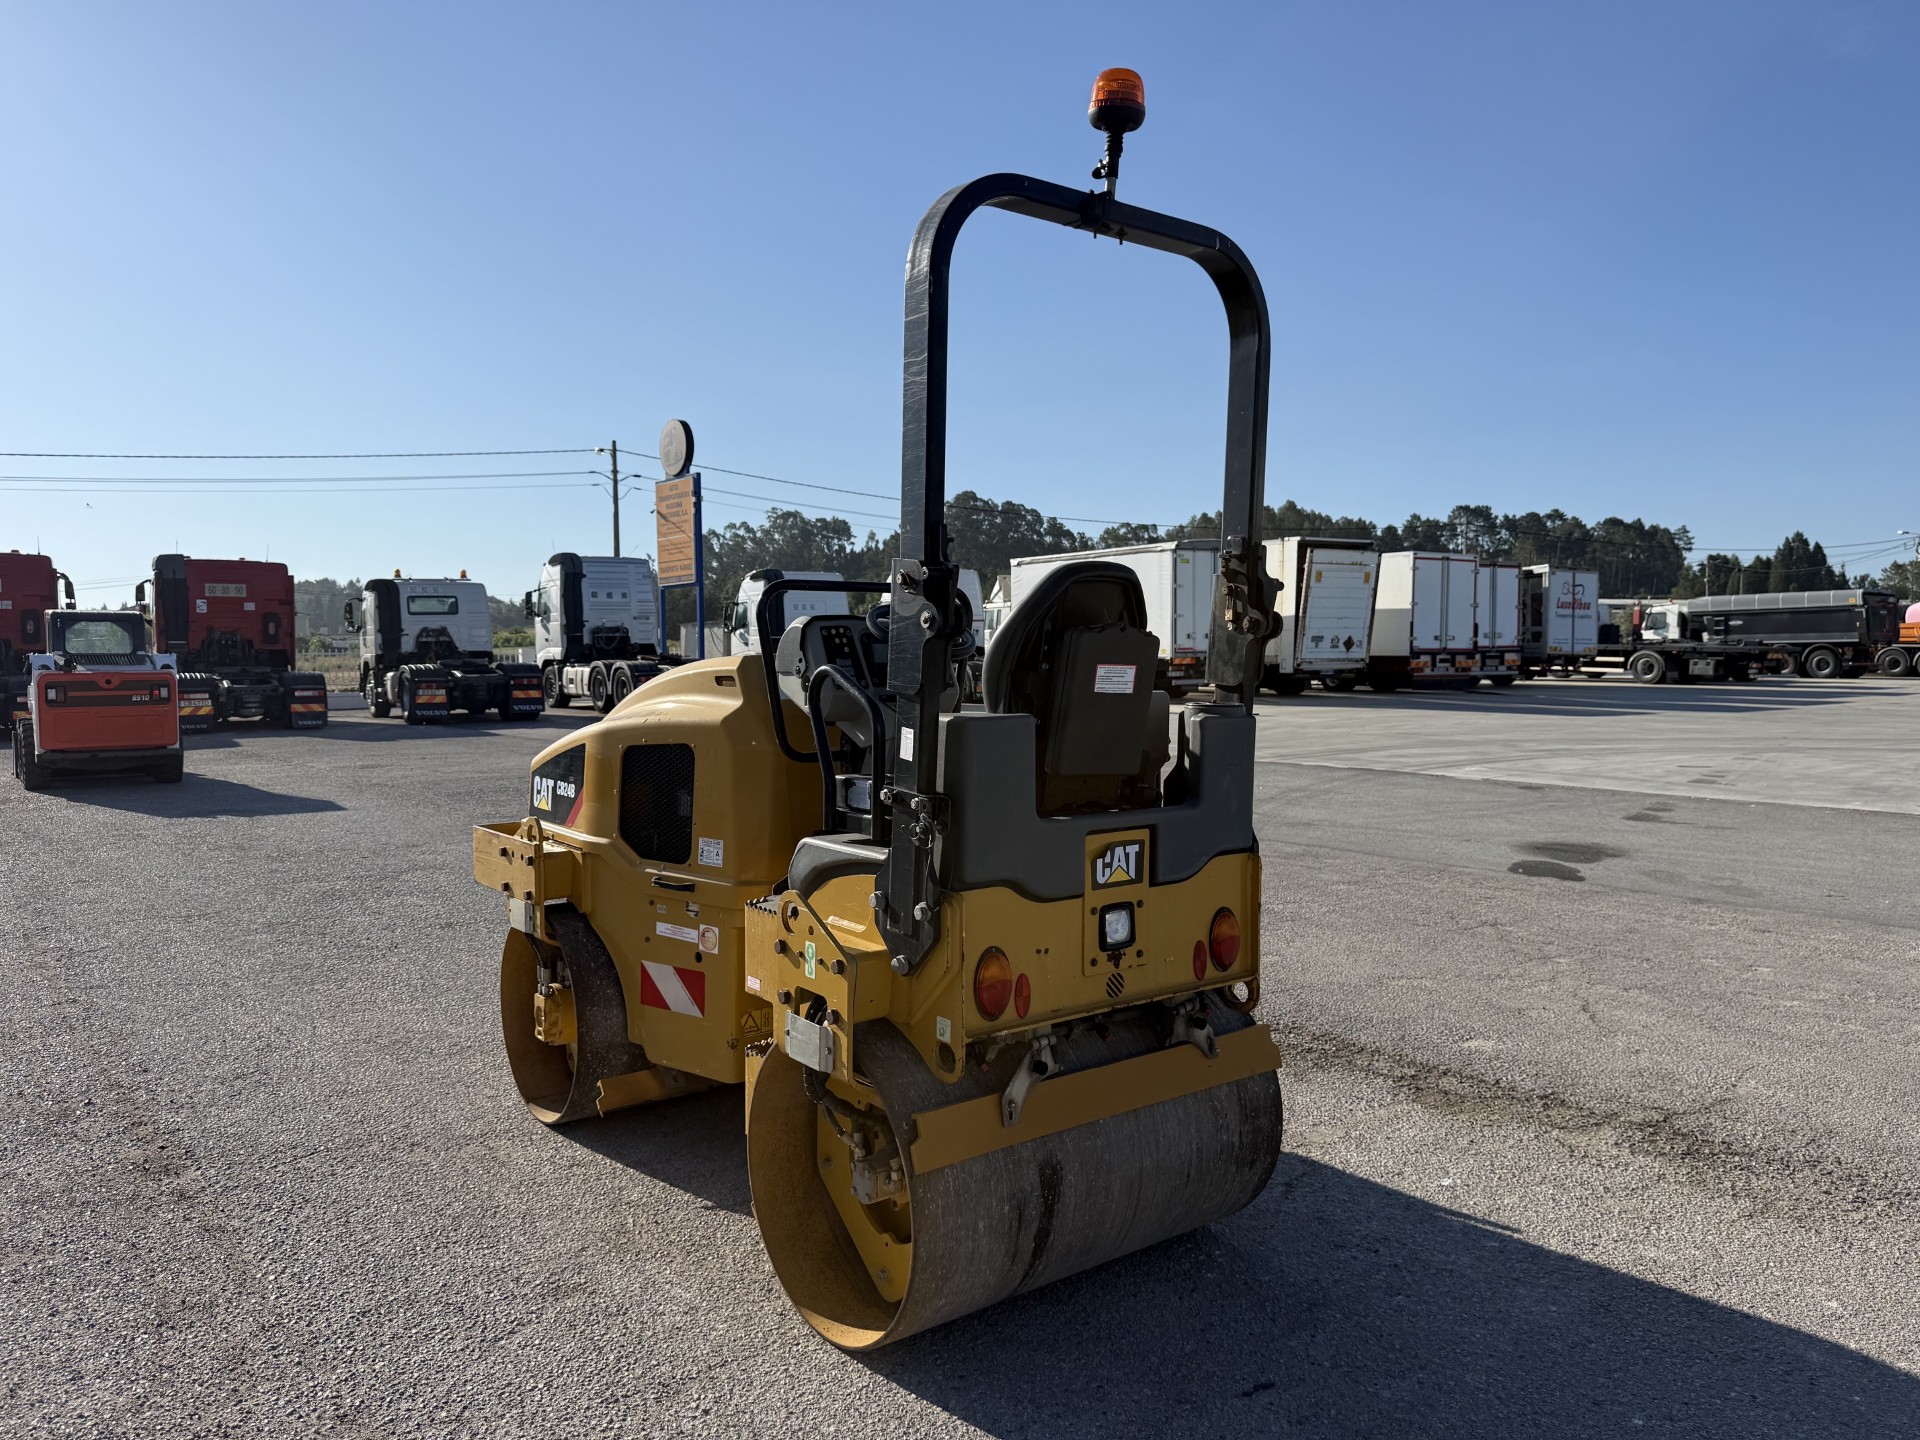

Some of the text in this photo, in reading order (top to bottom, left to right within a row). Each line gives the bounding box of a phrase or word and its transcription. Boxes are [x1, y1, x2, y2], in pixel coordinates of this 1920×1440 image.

[533, 775, 576, 811] CAT CB24B
[1096, 843, 1140, 884] CAT
